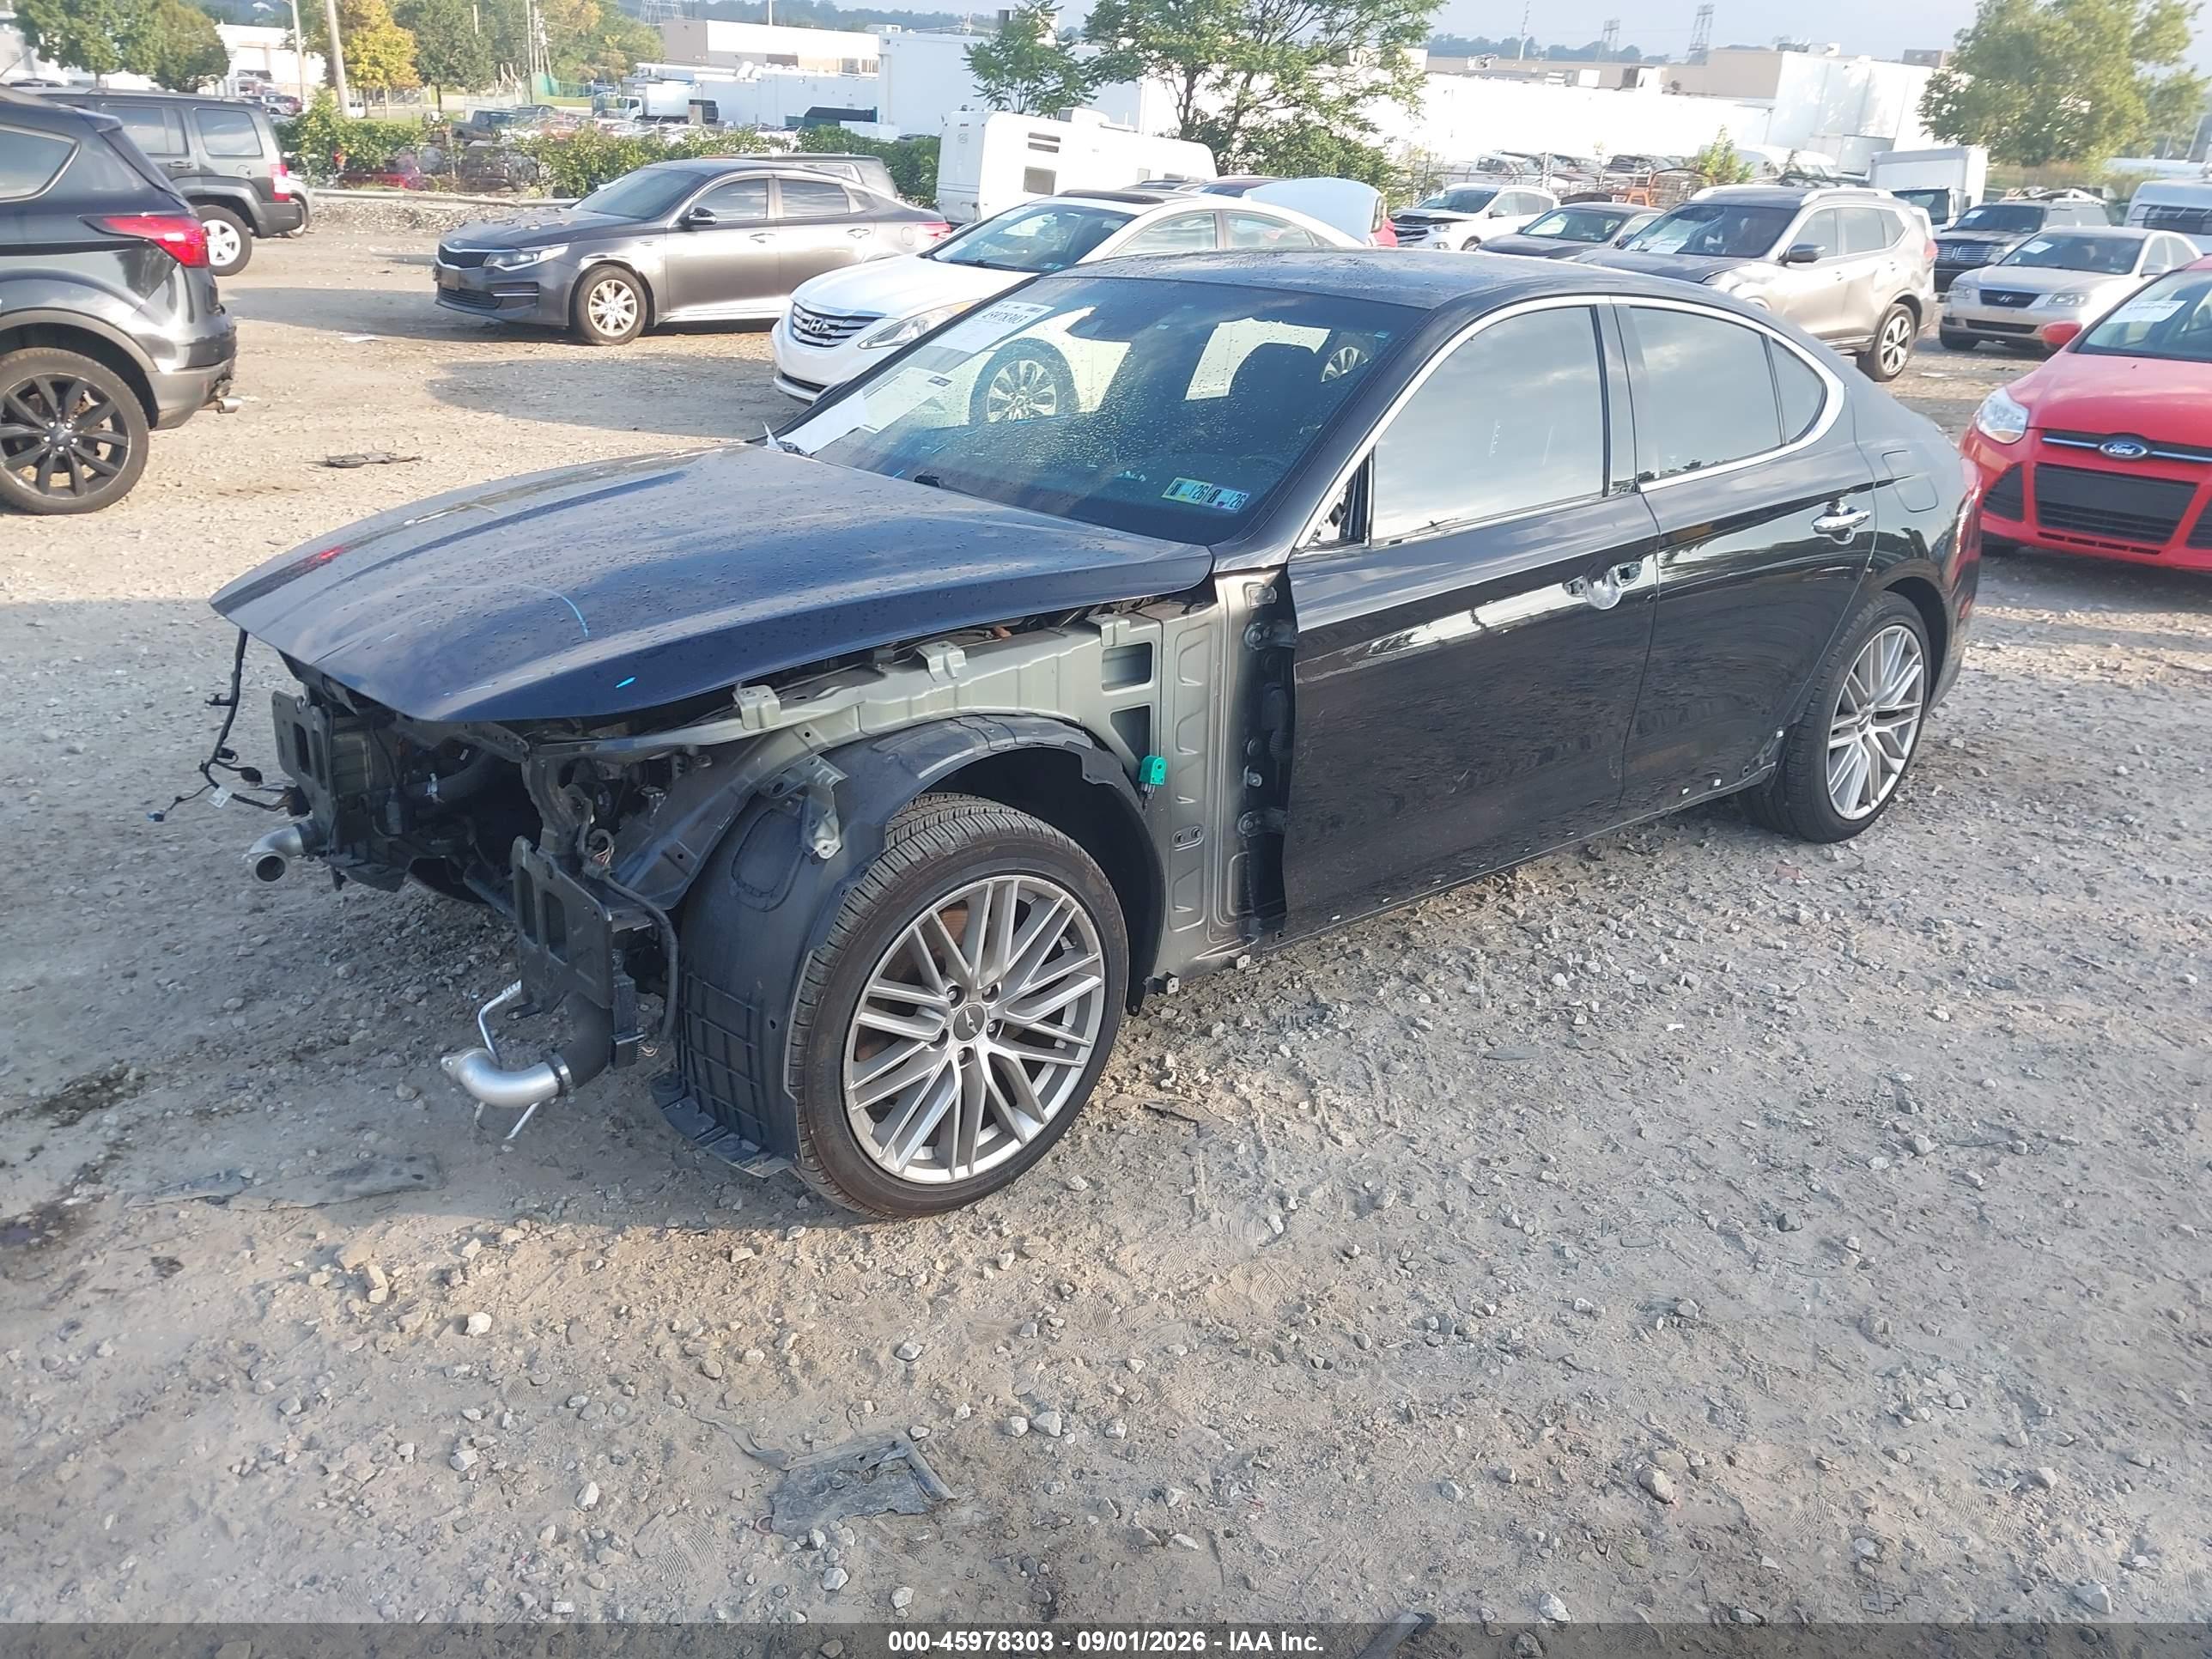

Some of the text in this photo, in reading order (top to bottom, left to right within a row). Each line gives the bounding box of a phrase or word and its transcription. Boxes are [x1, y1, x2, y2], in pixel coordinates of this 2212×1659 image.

[2108, 442, 2136, 455] Ford
[1170, 483, 1210, 501] 8 26
[1207, 489, 1247, 508] 8 26
